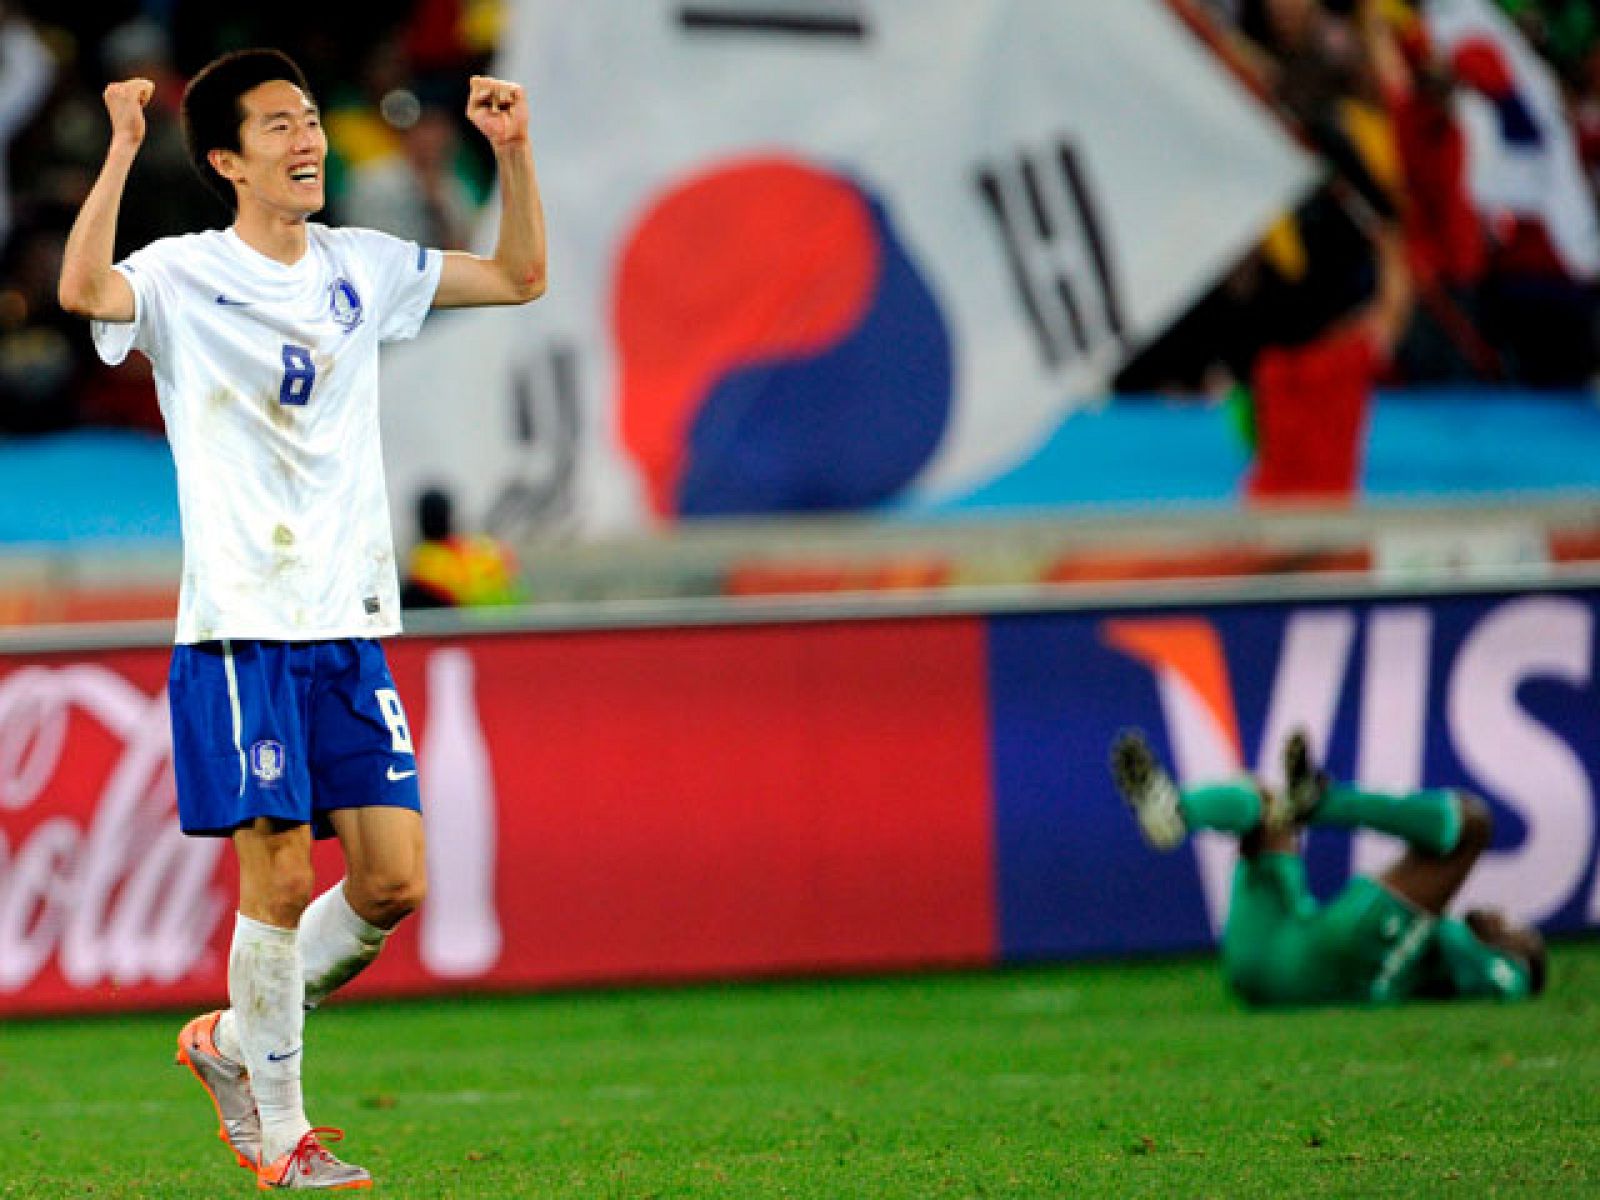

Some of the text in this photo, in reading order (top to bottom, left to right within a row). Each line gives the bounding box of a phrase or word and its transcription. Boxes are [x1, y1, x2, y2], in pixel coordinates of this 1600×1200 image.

[280, 344, 316, 406] 8
[374, 689, 415, 754] 8
[1104, 597, 1600, 940] VIS
